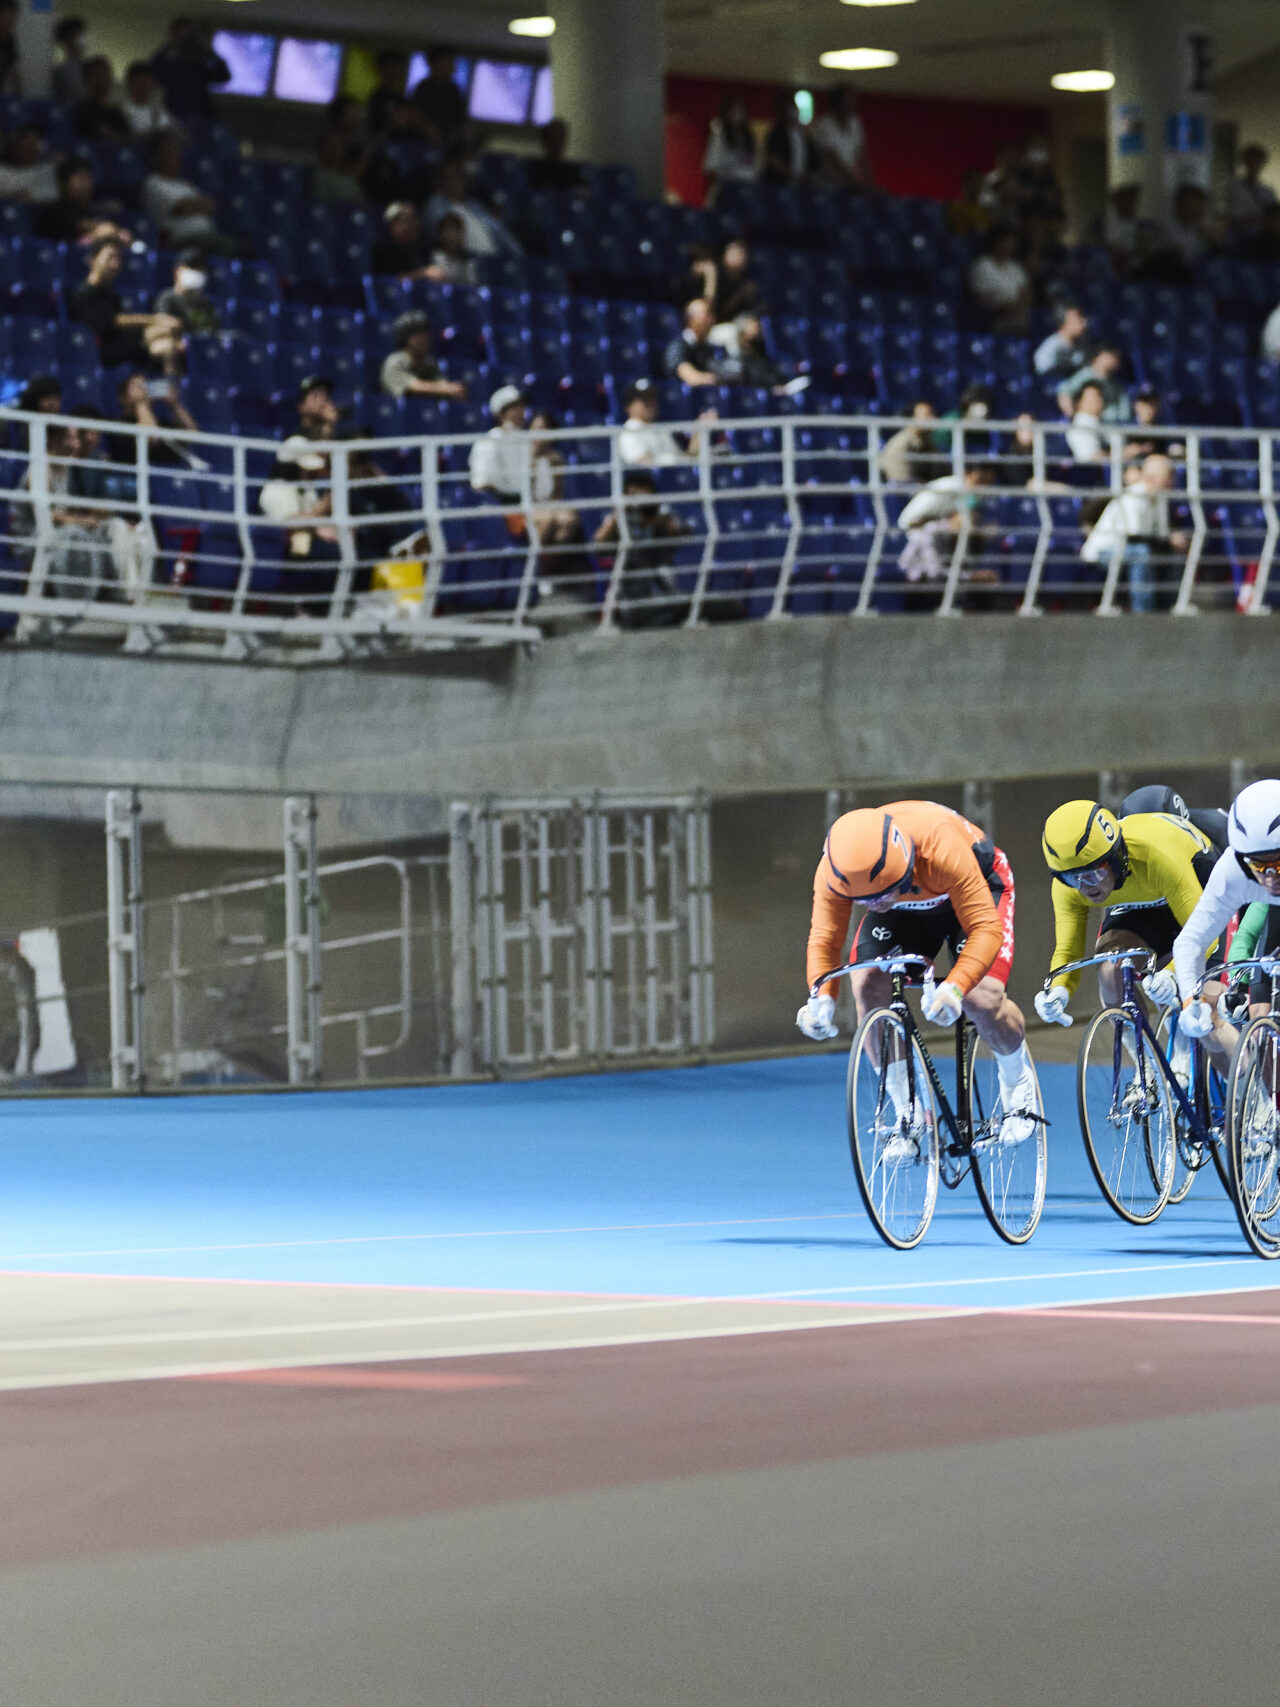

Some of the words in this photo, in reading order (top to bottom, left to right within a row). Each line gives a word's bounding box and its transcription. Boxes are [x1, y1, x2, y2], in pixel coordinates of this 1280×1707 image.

[1173, 794, 1190, 821] 2
[891, 823, 910, 863] 7
[1096, 812, 1117, 843] 5
